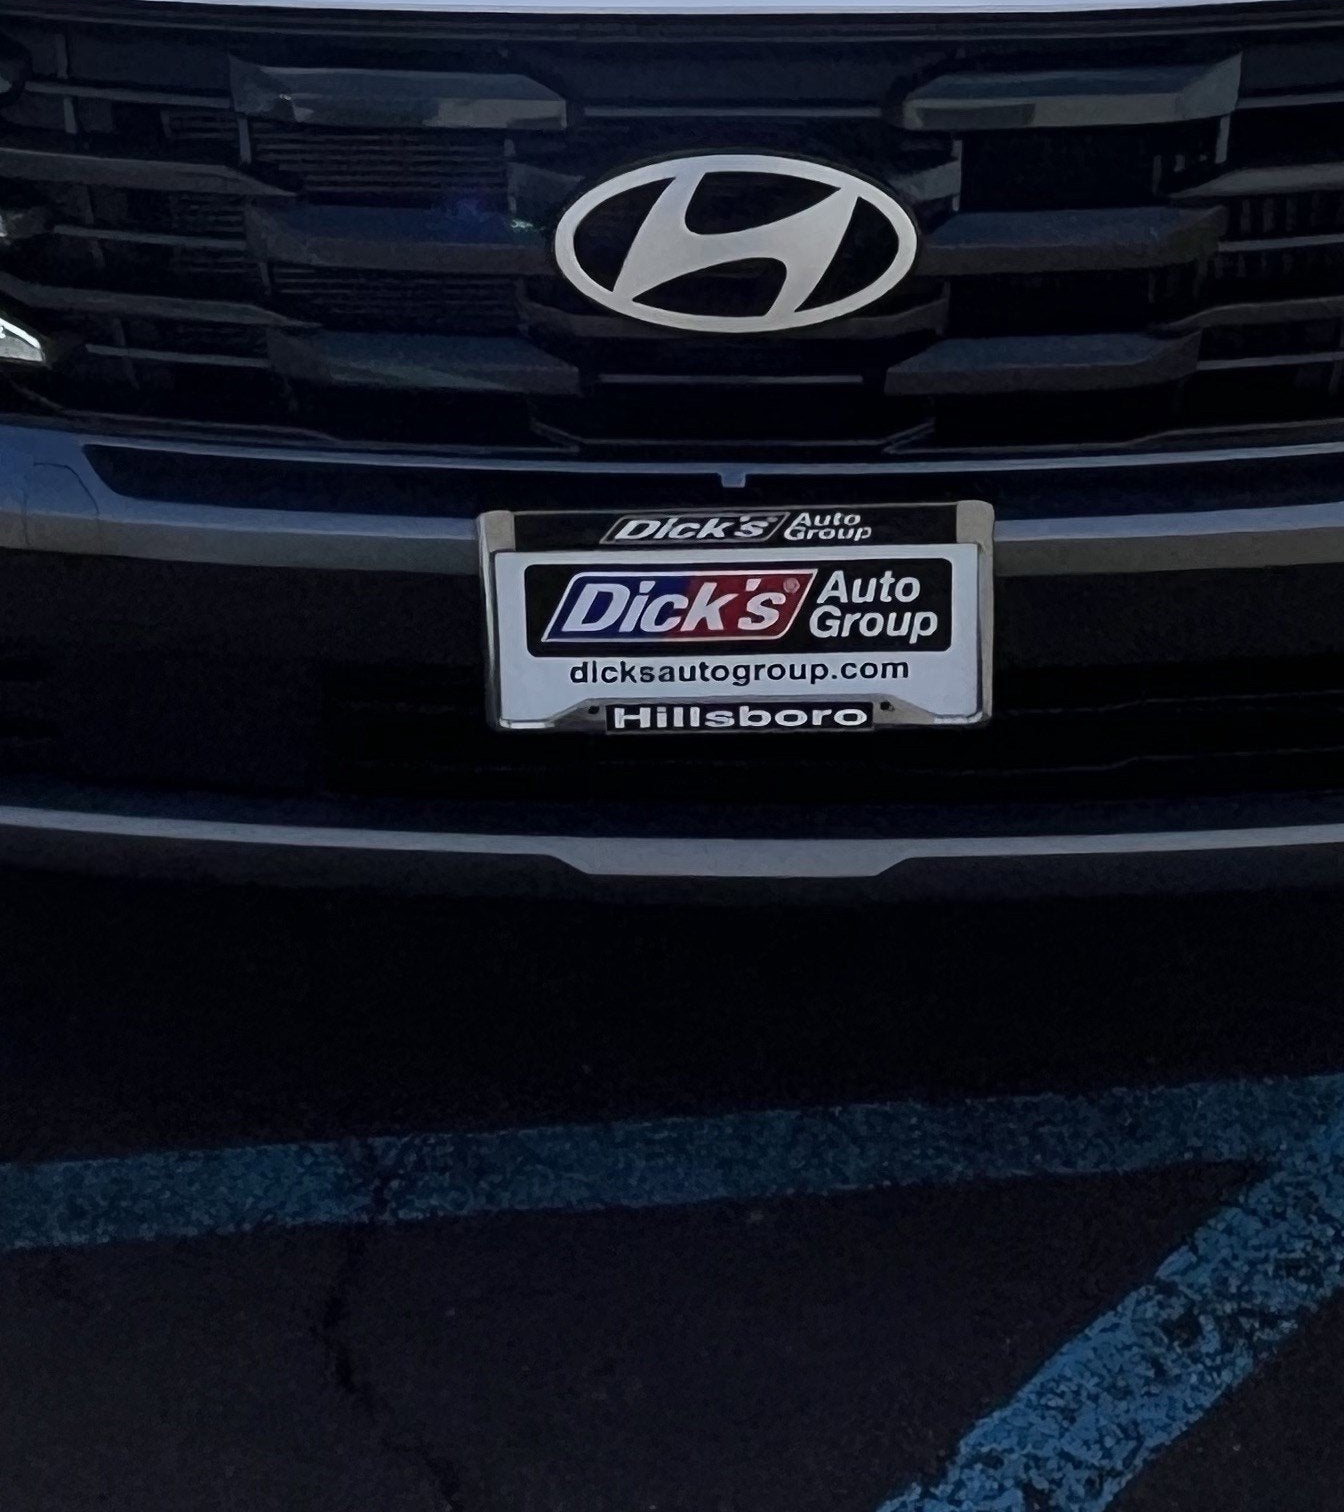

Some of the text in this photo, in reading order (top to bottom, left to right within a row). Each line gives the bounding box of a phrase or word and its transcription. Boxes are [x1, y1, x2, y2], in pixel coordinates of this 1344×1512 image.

[613, 514, 770, 541] Dick's
[792, 512, 862, 527] Auto
[783, 525, 873, 542] Group
[816, 569, 922, 605] Auto
[561, 578, 786, 634] Dick's
[808, 605, 940, 645] Group
[569, 660, 910, 686] dicksautogroup.com
[613, 706, 869, 730] Hillsboro
